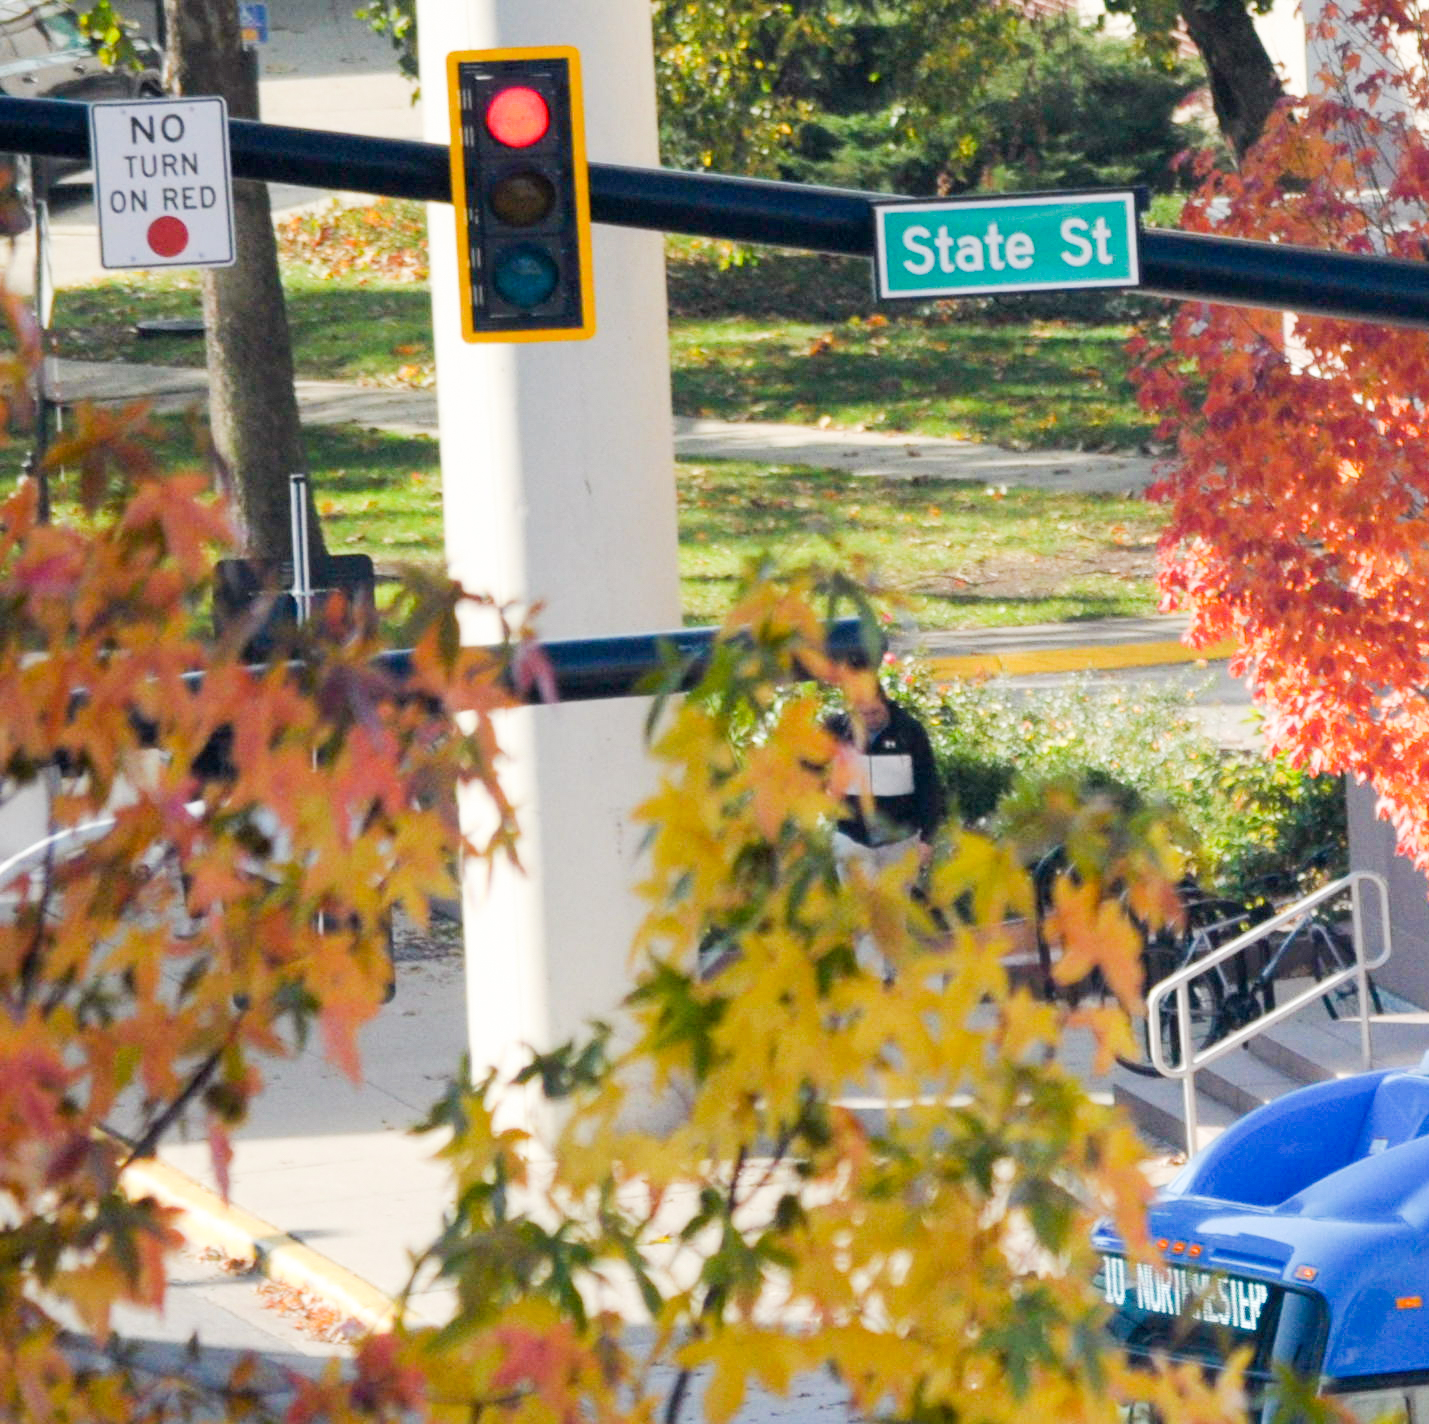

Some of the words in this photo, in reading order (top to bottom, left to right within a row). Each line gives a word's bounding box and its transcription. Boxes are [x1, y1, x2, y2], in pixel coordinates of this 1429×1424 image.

[130, 114, 185, 144] NO
[124, 153, 199, 179] TURN
[110, 190, 147, 213] ON
[163, 186, 216, 210] RED
[902, 221, 1035, 275] State
[1060, 217, 1113, 267] St
